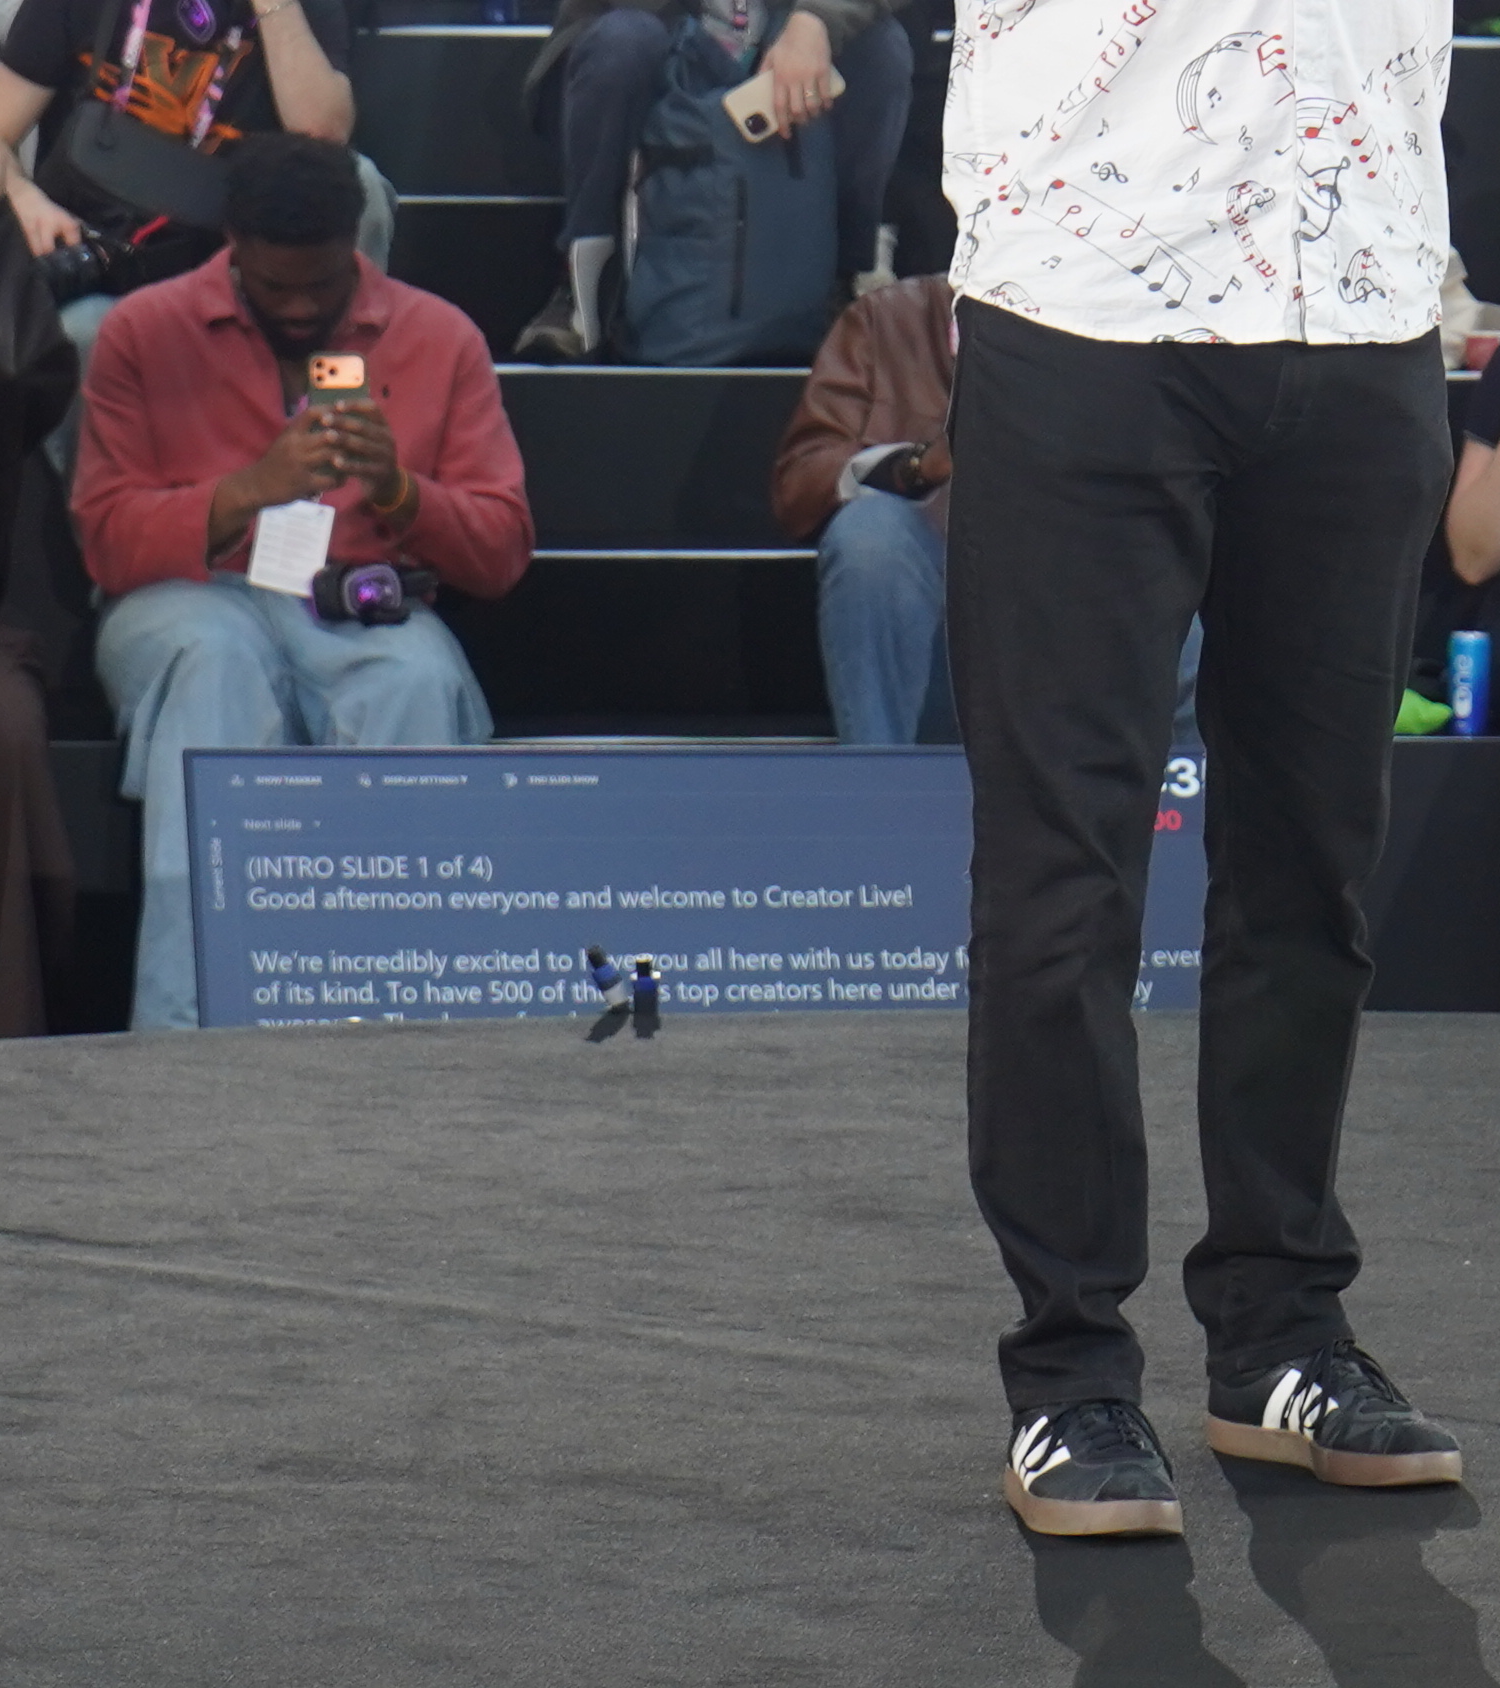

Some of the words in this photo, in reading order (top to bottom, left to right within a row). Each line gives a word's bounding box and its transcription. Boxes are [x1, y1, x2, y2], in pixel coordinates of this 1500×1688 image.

[243, 818, 272, 830] Next
[274, 817, 302, 830] slide
[246, 856, 334, 882] (INTRO
[341, 856, 409, 880] SLIDE
[418, 857, 429, 879] 1
[436, 855, 465, 880] of
[467, 856, 493, 882] 4)
[248, 885, 316, 910] Good
[323, 886, 443, 910] afternoon
[450, 889, 560, 914] everyone
[566, 885, 612, 909] and
[618, 885, 726, 909] welcome
[731, 888, 758, 909] to
[763, 885, 853, 909] Creator
[858, 884, 914, 909] Live!
[251, 950, 323, 974] We're
[329, 949, 448, 979] incredibly
[454, 949, 540, 973] excited
[545, 952, 573, 973] to
[694, 947, 722, 971] all
[729, 947, 783, 971] here
[787, 947, 841, 971] with
[845, 952, 875, 971] us
[879, 946, 950, 975] today
[253, 979, 280, 1004] of
[285, 980, 315, 1004] its
[320, 979, 380, 1004] kind.
[384, 980, 418, 1004] To
[423, 979, 482, 1004] have
[489, 980, 534, 1004] 500
[539, 979, 566, 1003] of
[571, 979, 606, 1003] th
[677, 981, 720, 1007] top
[725, 980, 823, 1003] creators
[828, 978, 883, 1003] here
[888, 977, 961, 1002] under
